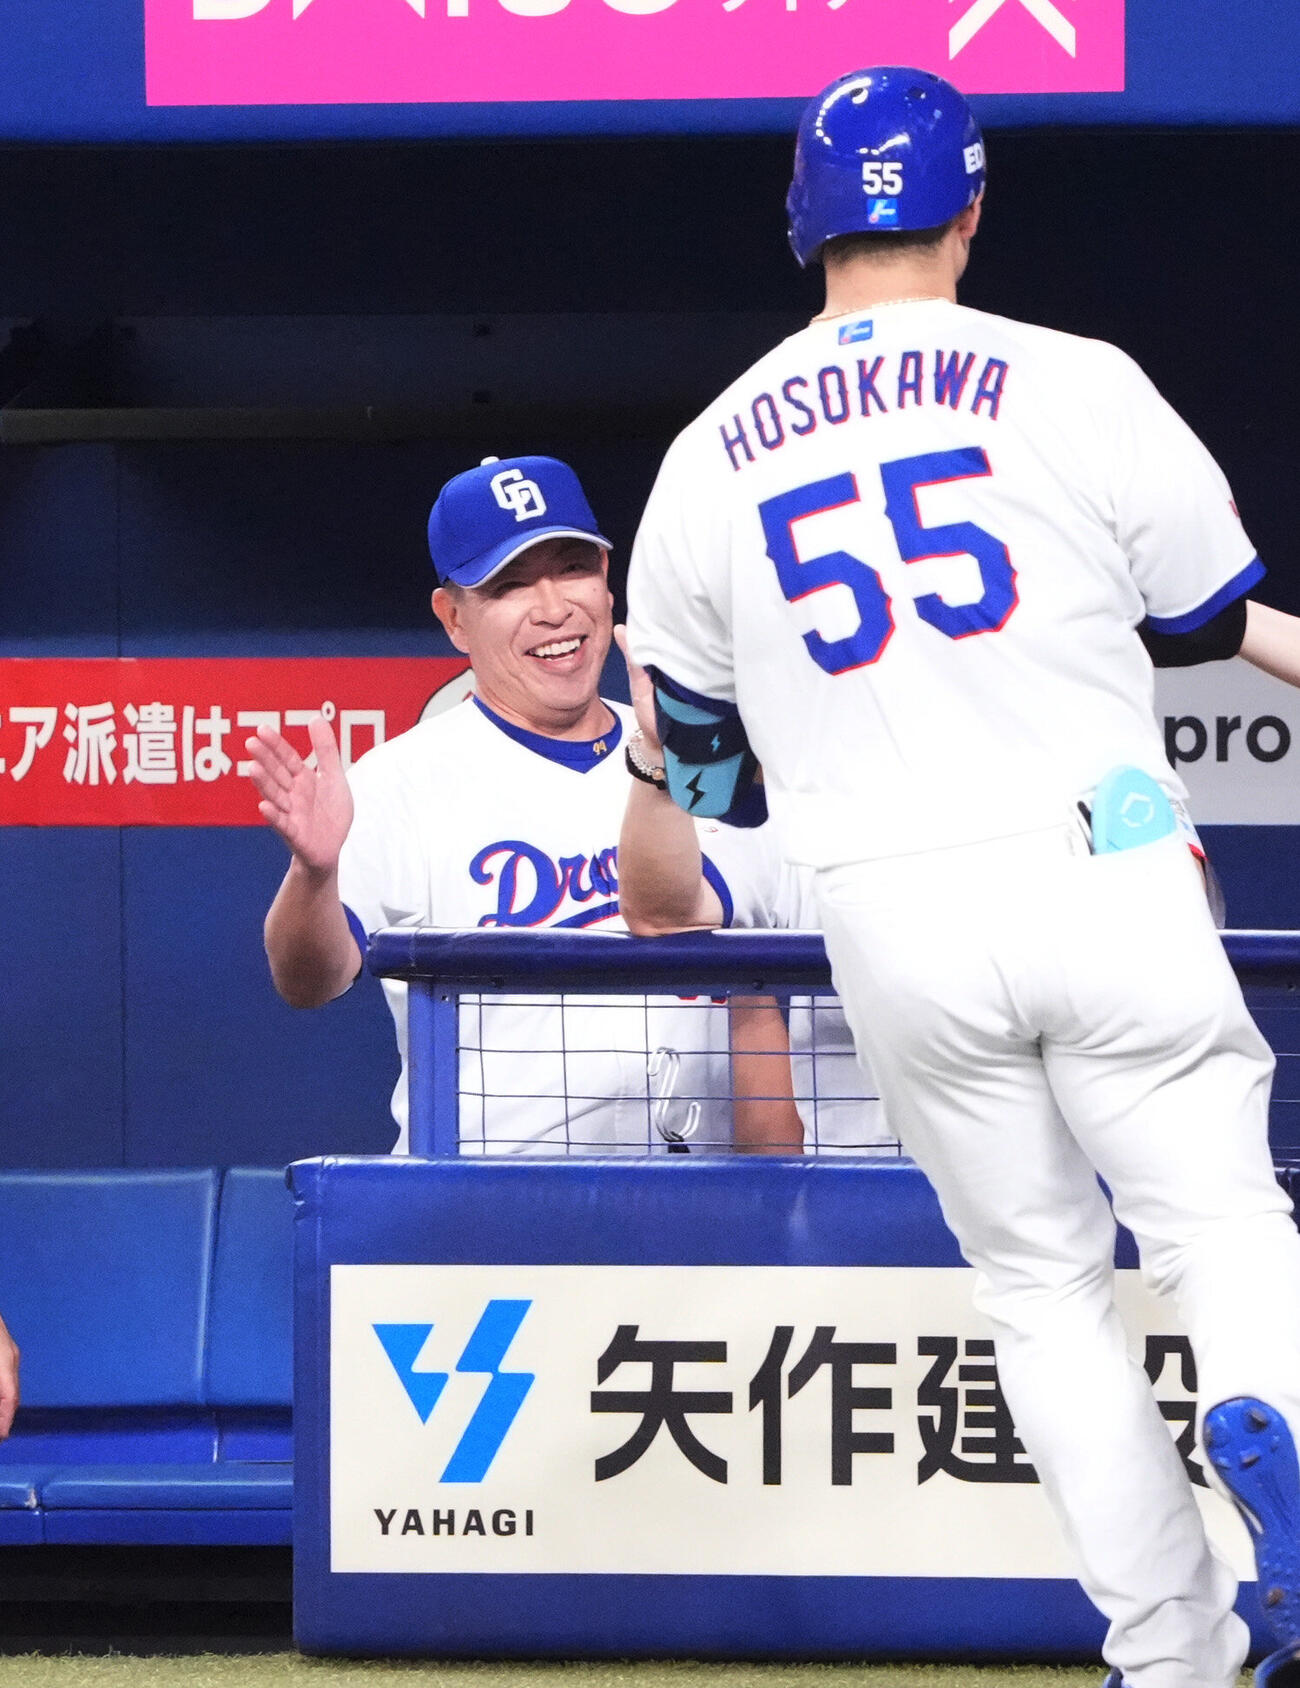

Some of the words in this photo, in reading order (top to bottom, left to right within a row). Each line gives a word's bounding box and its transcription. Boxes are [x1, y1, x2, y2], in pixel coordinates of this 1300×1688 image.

[862, 162, 903, 195] 55
[719, 350, 1009, 471] HOSOKAWA
[758, 446, 1020, 676] 55
[373, 1509, 534, 1536] YAHAGI
